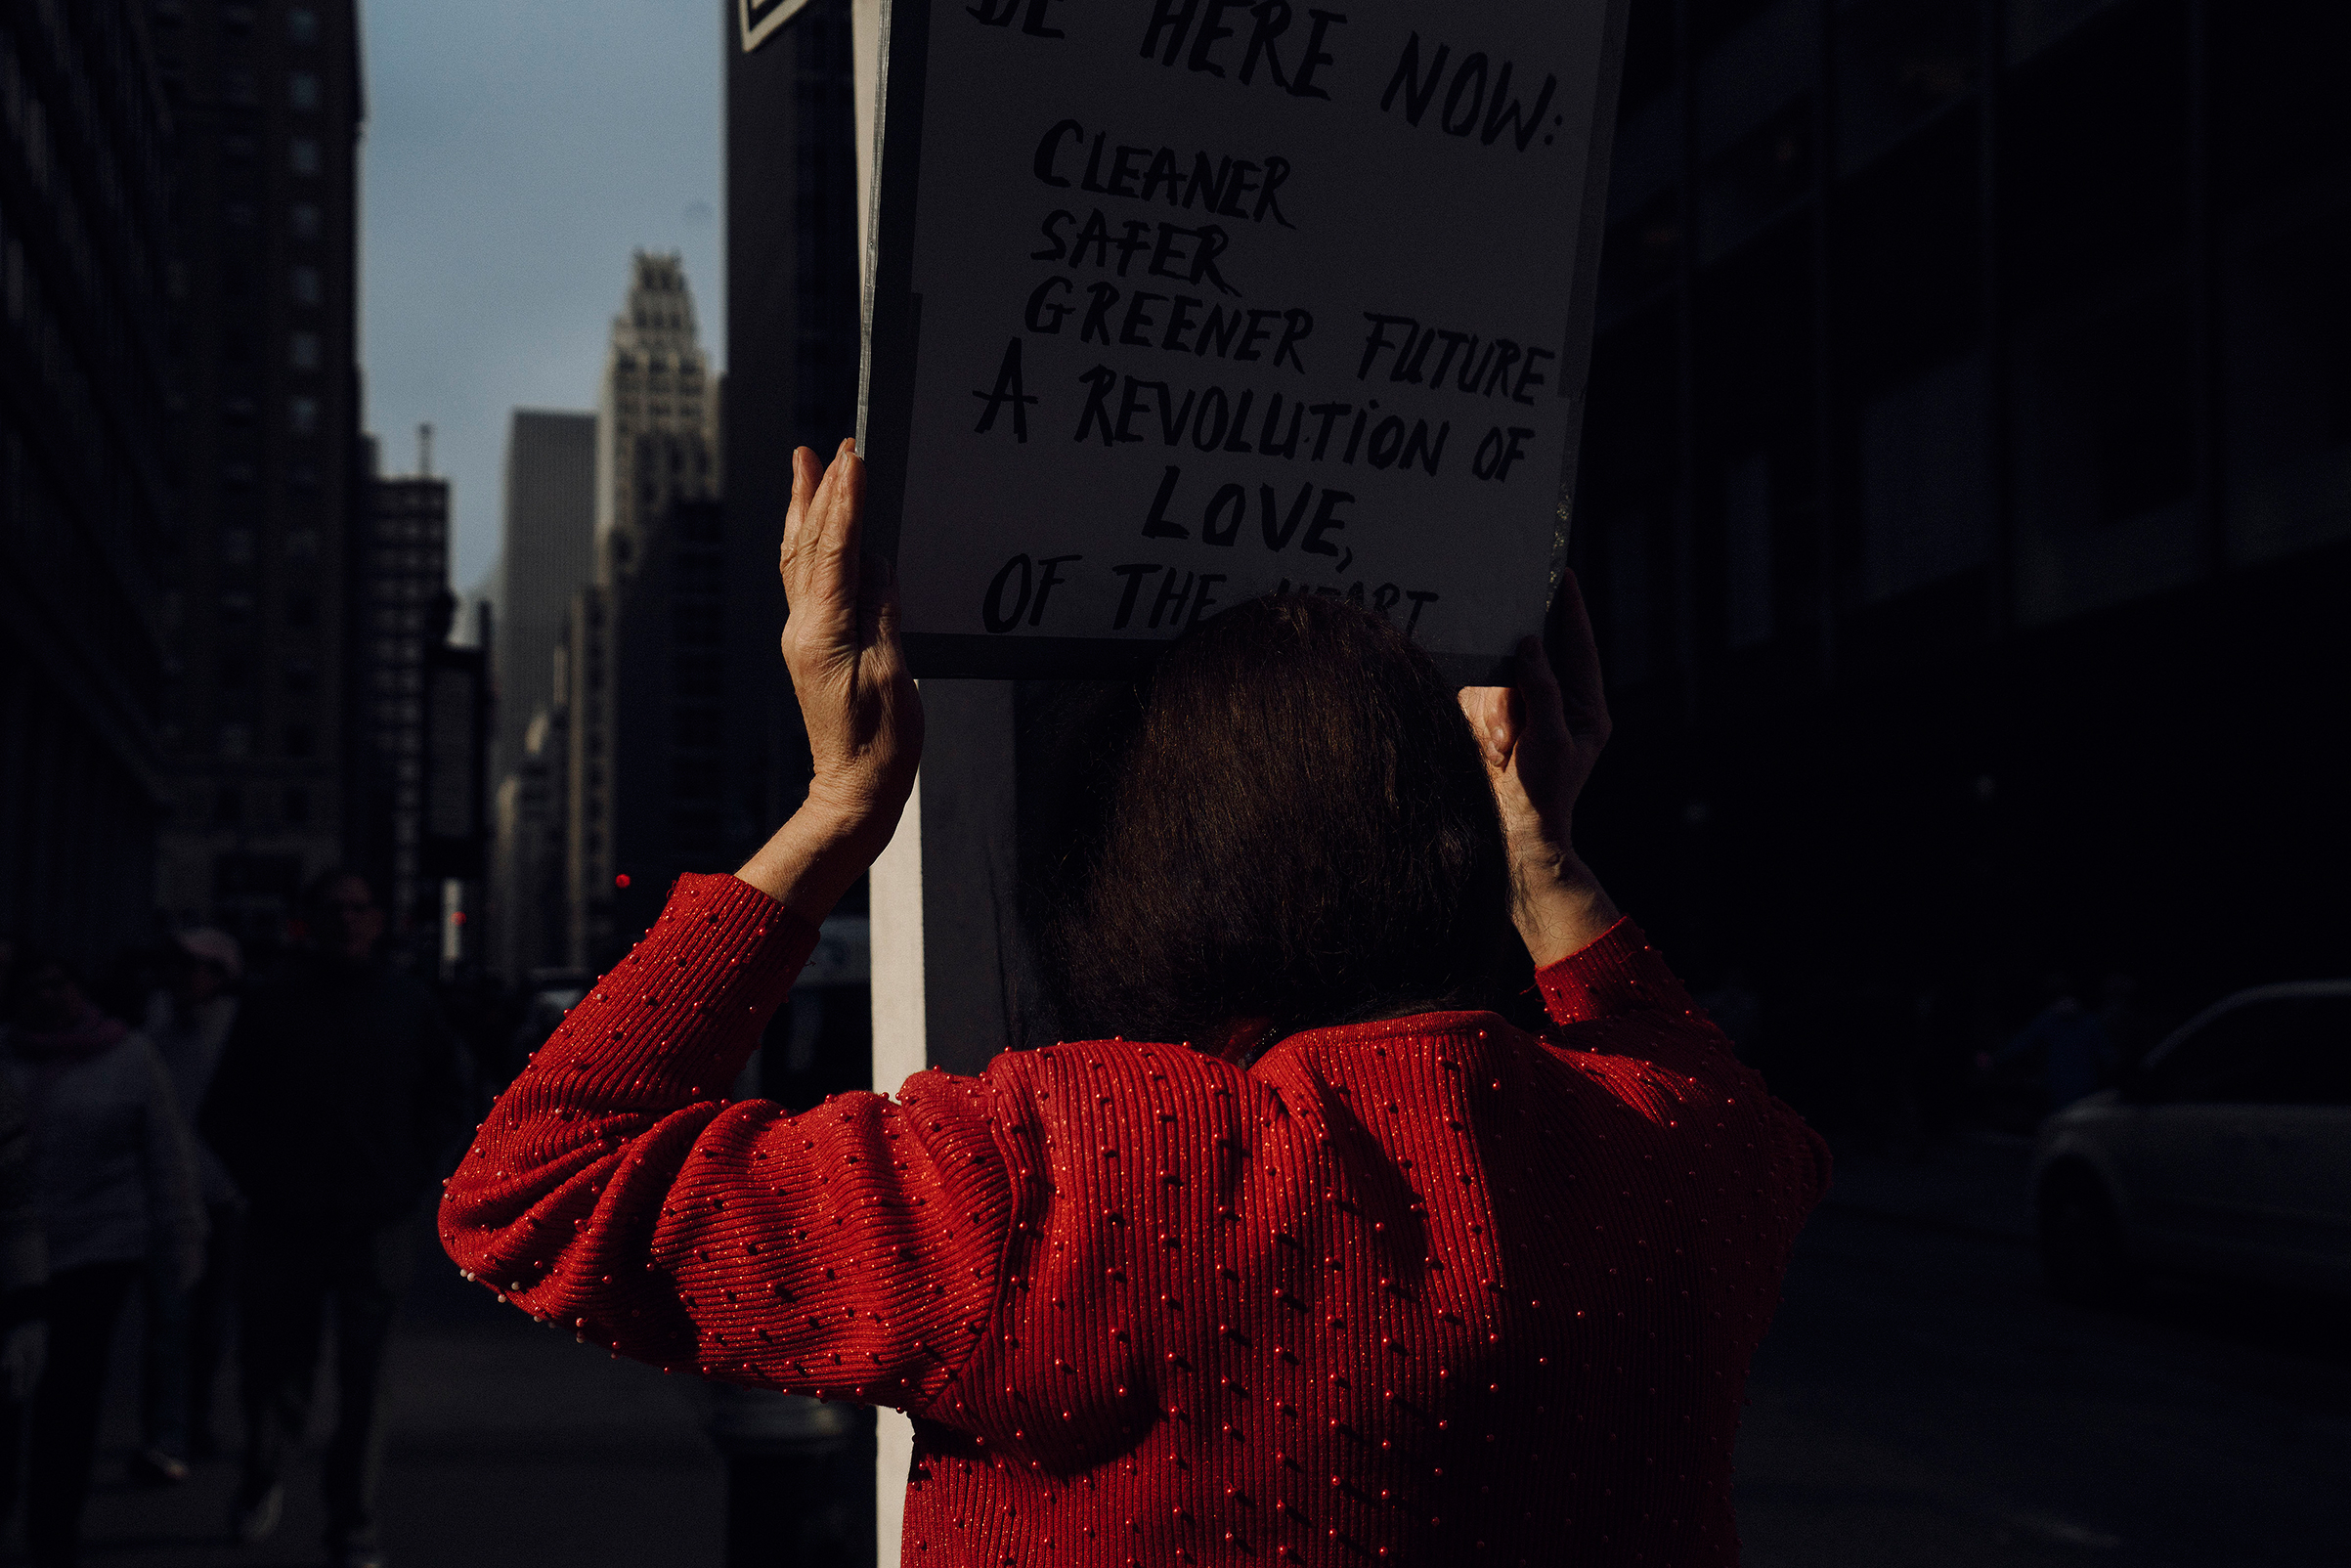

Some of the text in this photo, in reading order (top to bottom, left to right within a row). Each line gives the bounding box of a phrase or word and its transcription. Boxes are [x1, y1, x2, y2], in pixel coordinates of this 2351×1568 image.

[1140, 0, 1562, 152] HERE NOW:
[1033, 119, 1296, 230] CLEANER
[1030, 208, 1241, 297] SAFER
[1024, 276, 1554, 406] GREENER FUTURE
[973, 336, 1038, 443] A
[1472, 427, 1535, 482] OF
[1142, 465, 1355, 573] LOVE,
[982, 553, 1082, 633] OF
[1112, 564, 1227, 632] THE
